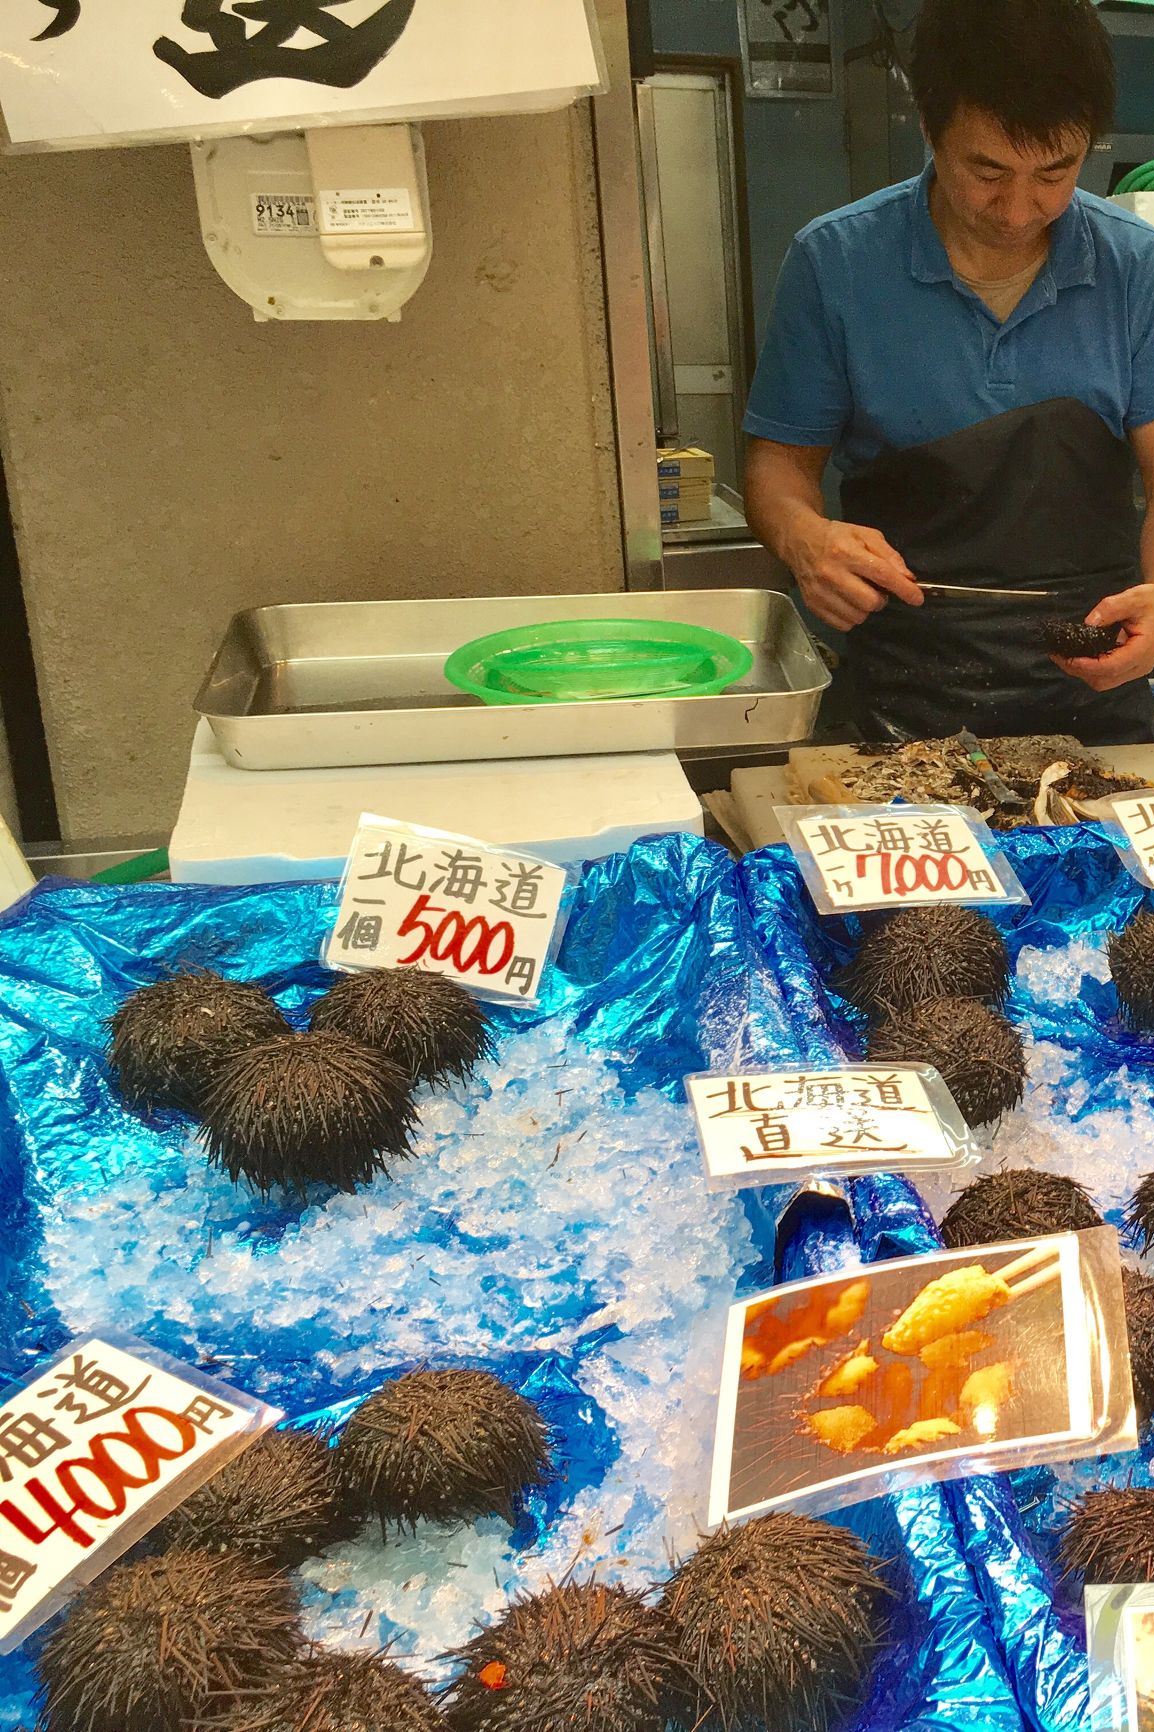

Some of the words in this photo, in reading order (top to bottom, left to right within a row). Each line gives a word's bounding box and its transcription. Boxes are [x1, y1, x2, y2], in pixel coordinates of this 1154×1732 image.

[256, 204, 294, 217] 9134
[810, 819, 970, 855] 北海道
[358, 840, 547, 919] 北海道
[706, 1073, 927, 1118] 北海道
